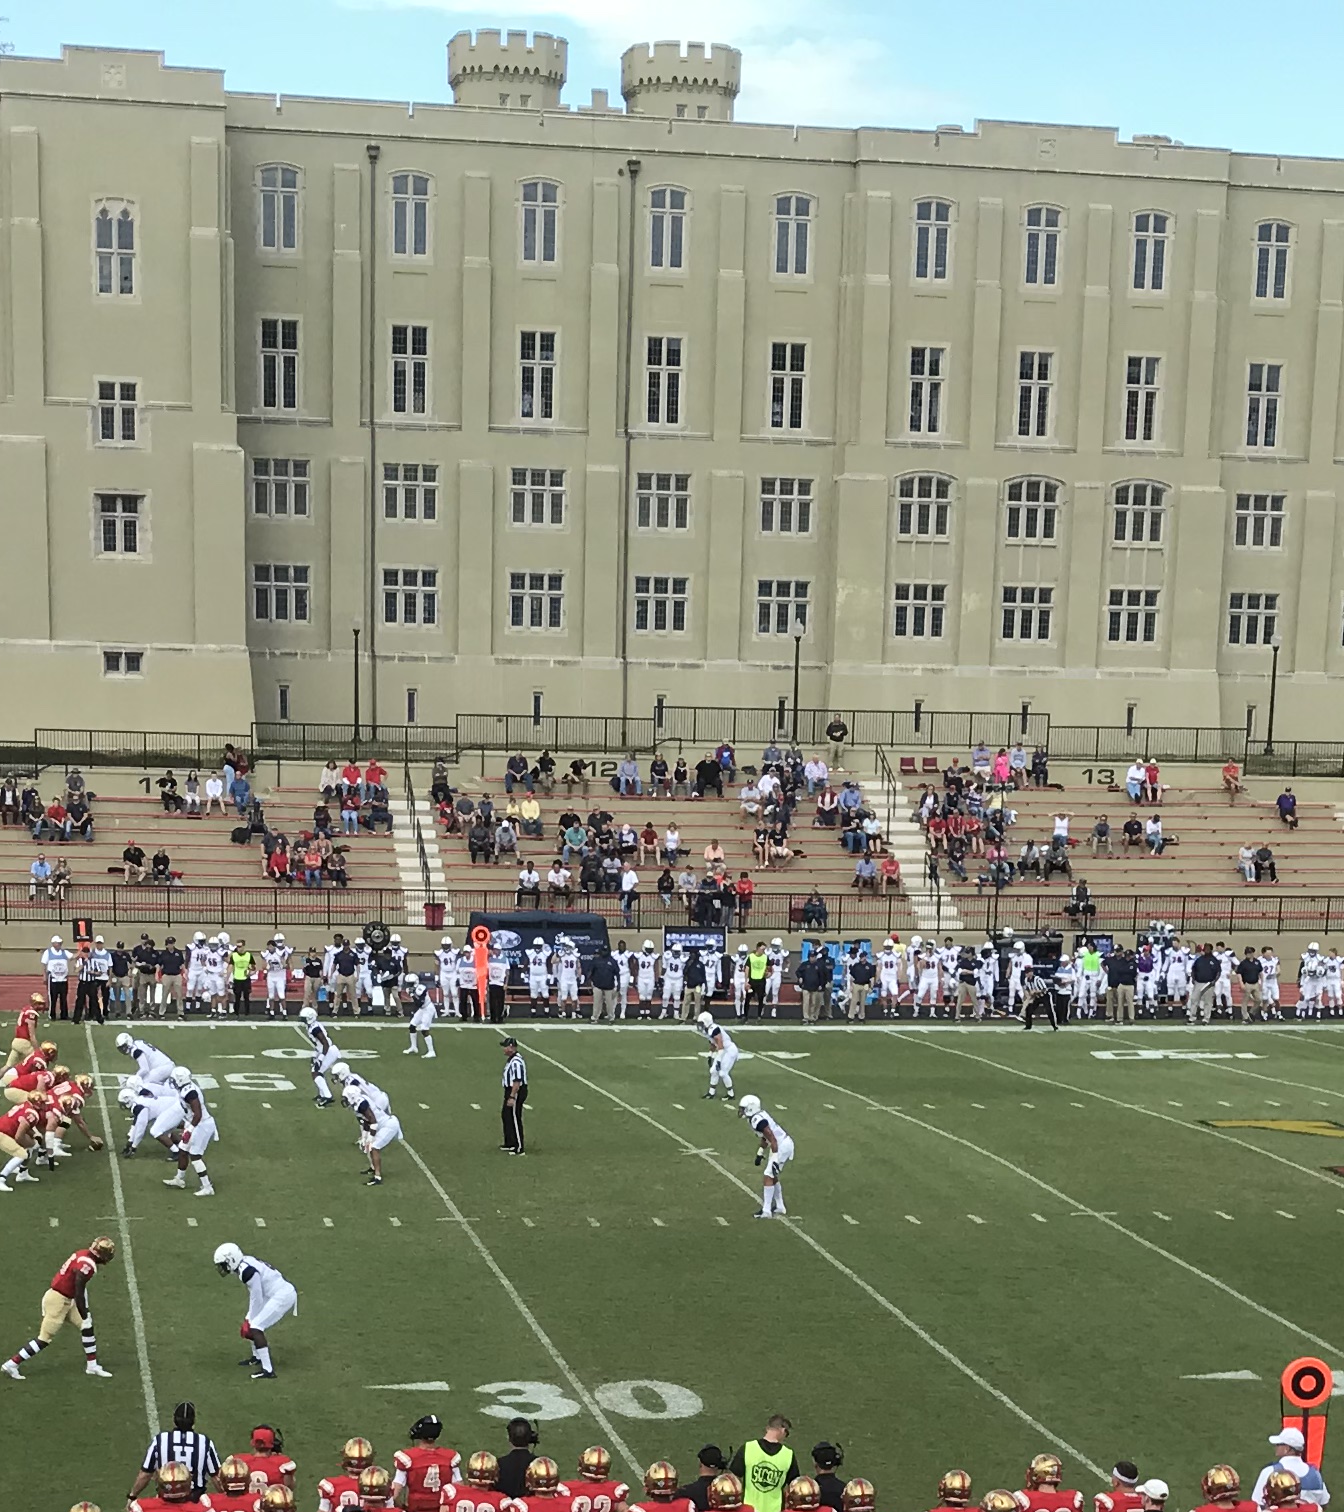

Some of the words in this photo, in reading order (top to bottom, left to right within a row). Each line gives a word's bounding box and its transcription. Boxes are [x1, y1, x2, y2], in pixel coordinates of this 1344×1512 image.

[587, 761, 618, 778] 12
[1082, 768, 1115, 785] 13
[473, 1379, 705, 1421] 30
[173, 1446, 195, 1472] H
[423, 1463, 442, 1493] 4
